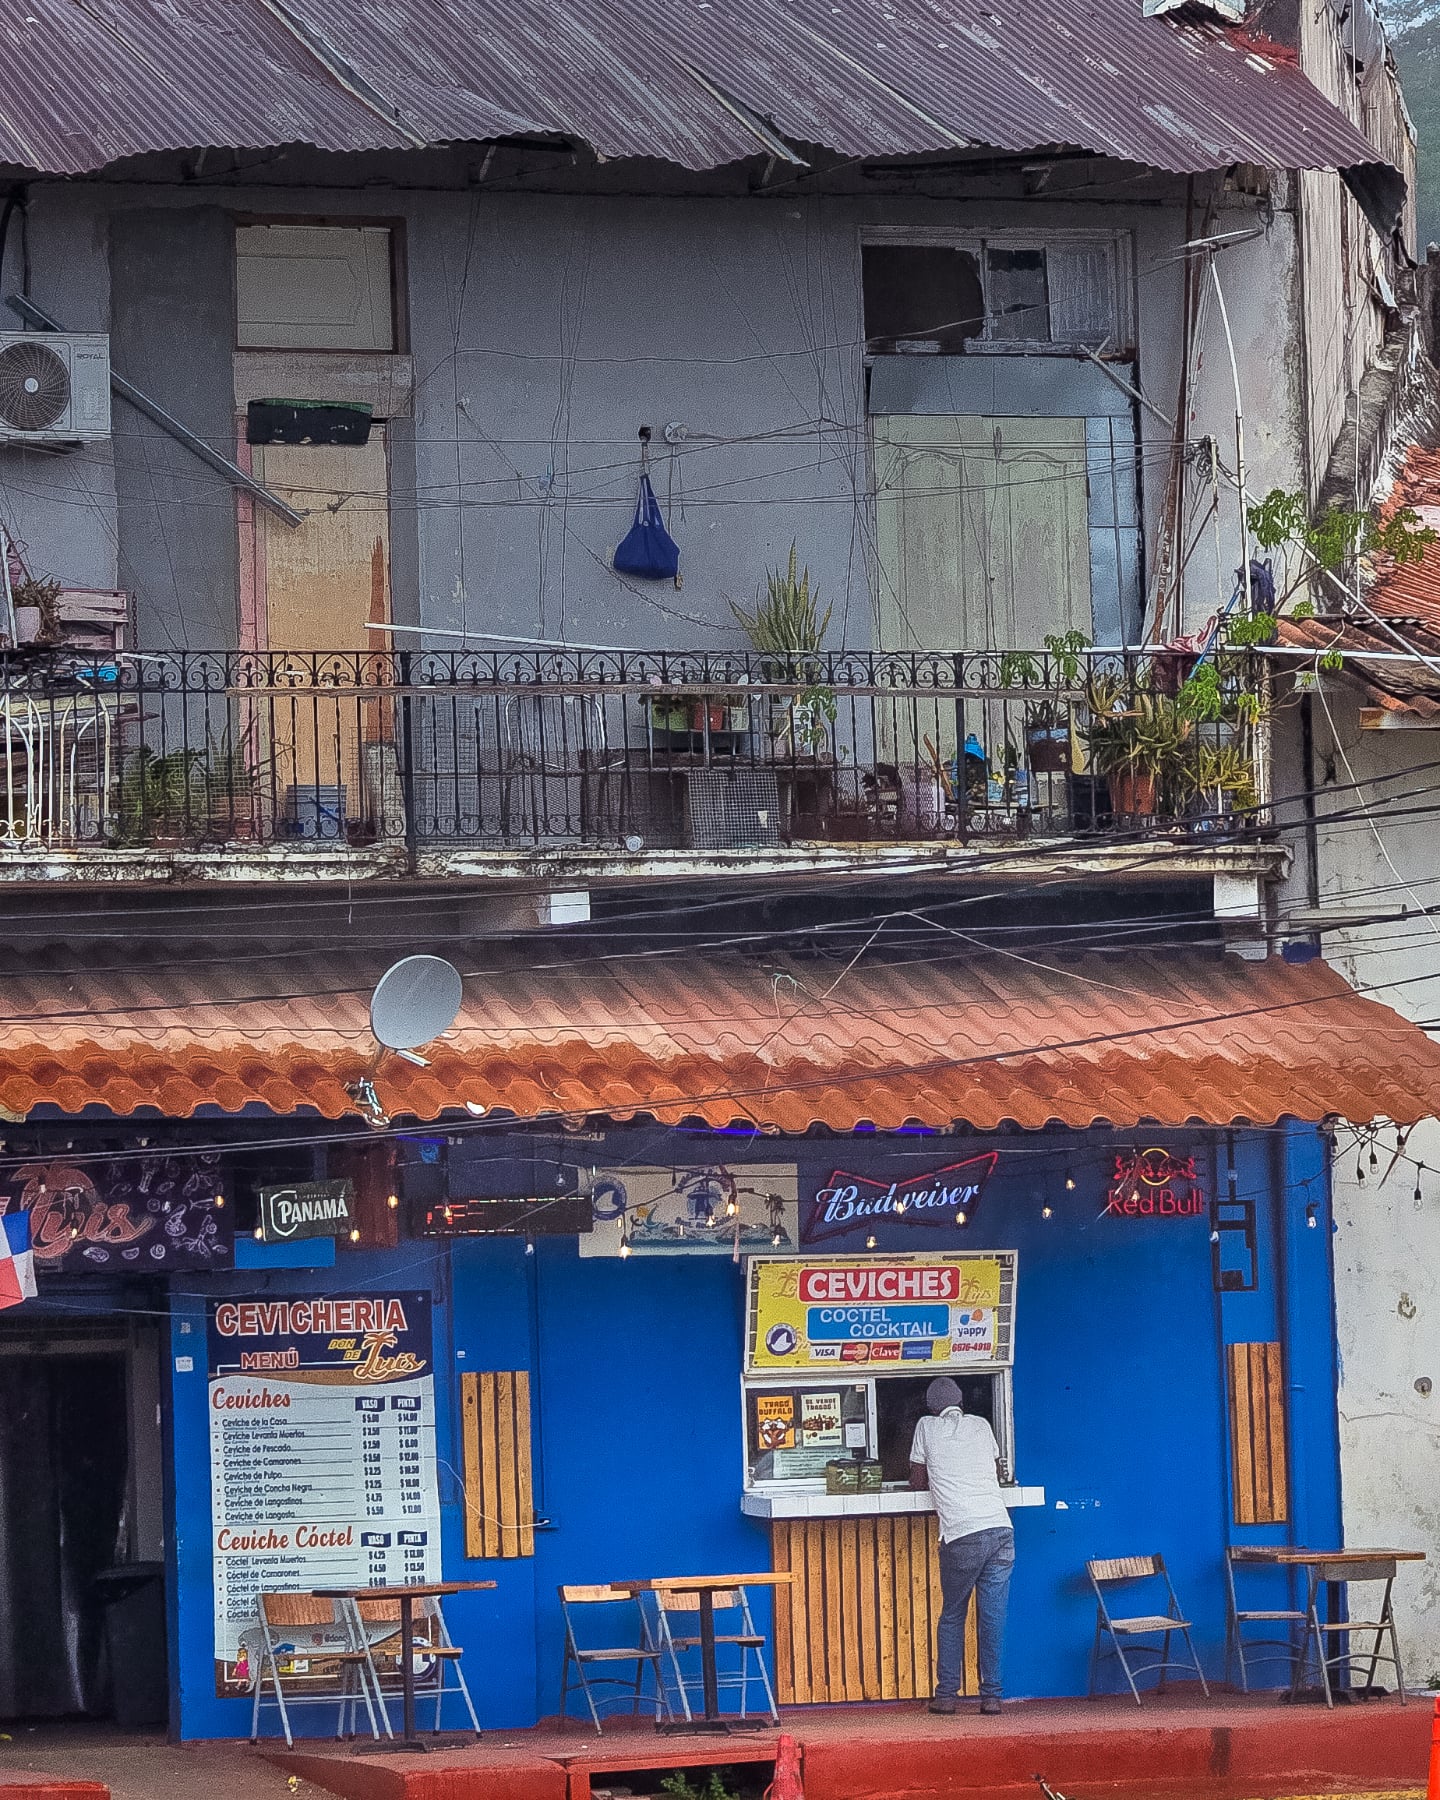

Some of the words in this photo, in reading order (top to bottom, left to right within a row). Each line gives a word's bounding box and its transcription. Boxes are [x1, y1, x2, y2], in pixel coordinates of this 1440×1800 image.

[816, 1183, 979, 1222] Budweiser
[1108, 1189, 1153, 1215] Red
[1160, 1189, 1204, 1214] Bull
[807, 1269, 953, 1299] CEVICHES
[215, 1299, 408, 1337] CEVICHERIA
[820, 1308, 891, 1323] COCTEL
[850, 1321, 938, 1337] COCKTAIL
[957, 1326, 987, 1337] yappy
[328, 1338, 356, 1350] DON
[343, 1350, 362, 1361] DE
[353, 1332, 426, 1380] Luis
[814, 1348, 836, 1357] VISA
[871, 1347, 900, 1357] Clave
[240, 1347, 299, 1370] MENÚ
[212, 1387, 291, 1410] Ceviches
[222, 1418, 250, 1427] Ceviche
[251, 1418, 261, 1426] de
[262, 1418, 268, 1426] la
[270, 1416, 287, 1426] Casa
[223, 1431, 250, 1440] Ceviche
[223, 1444, 251, 1454] Ceviche
[252, 1444, 261, 1453] de
[263, 1443, 291, 1453] Pescado
[223, 1458, 251, 1467] Ceviche
[253, 1457, 262, 1466] de
[263, 1457, 302, 1466] Camarones
[224, 1472, 251, 1481] Ceviche
[253, 1471, 262, 1480] de
[263, 1471, 282, 1480] Pulpo
[224, 1486, 252, 1494] Ceviche
[253, 1485, 262, 1493] de
[264, 1484, 291, 1492] Concha
[292, 1484, 313, 1493] Negra
[224, 1499, 253, 1508] Ceviche
[254, 1498, 263, 1507] de
[265, 1497, 302, 1508] Langostinos
[225, 1512, 253, 1521] Ceviche
[255, 1511, 264, 1519] de
[265, 1510, 295, 1521] Langosta
[218, 1528, 289, 1551] Ceviche
[295, 1524, 354, 1549] Cóctel
[250, 1570, 259, 1578] de
[261, 1569, 300, 1578] Camarones
[250, 1583, 260, 1592] de
[261, 1582, 300, 1593] Langostinos
